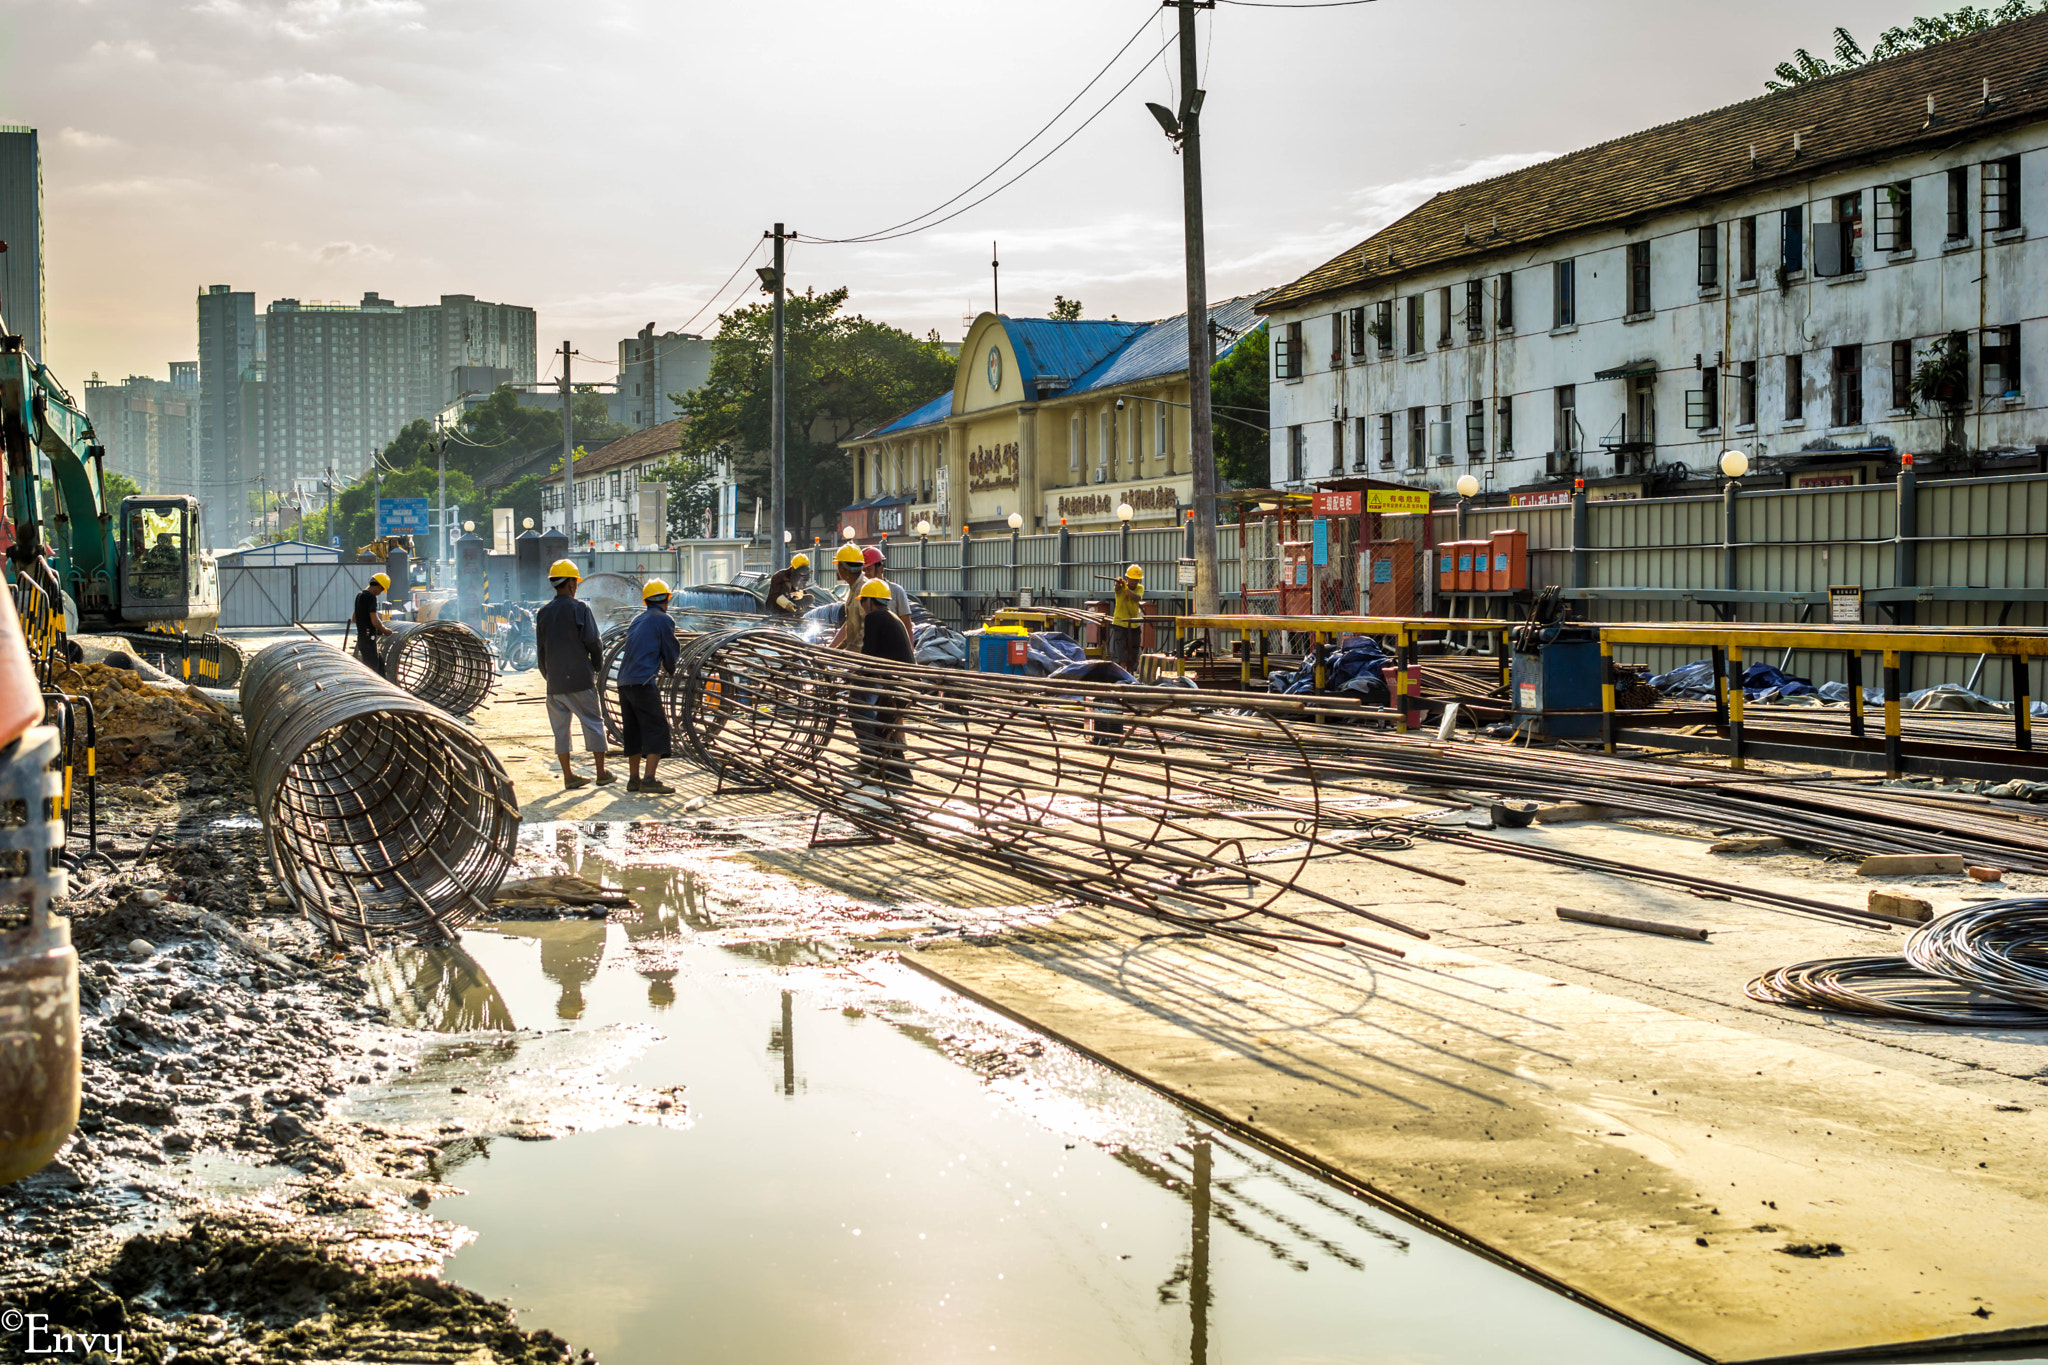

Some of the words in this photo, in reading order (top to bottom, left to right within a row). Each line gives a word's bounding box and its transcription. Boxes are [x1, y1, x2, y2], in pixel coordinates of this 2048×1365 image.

[1319, 495, 1353, 511] 二级配电柜
[463, 548, 479, 627] 精品人品同
